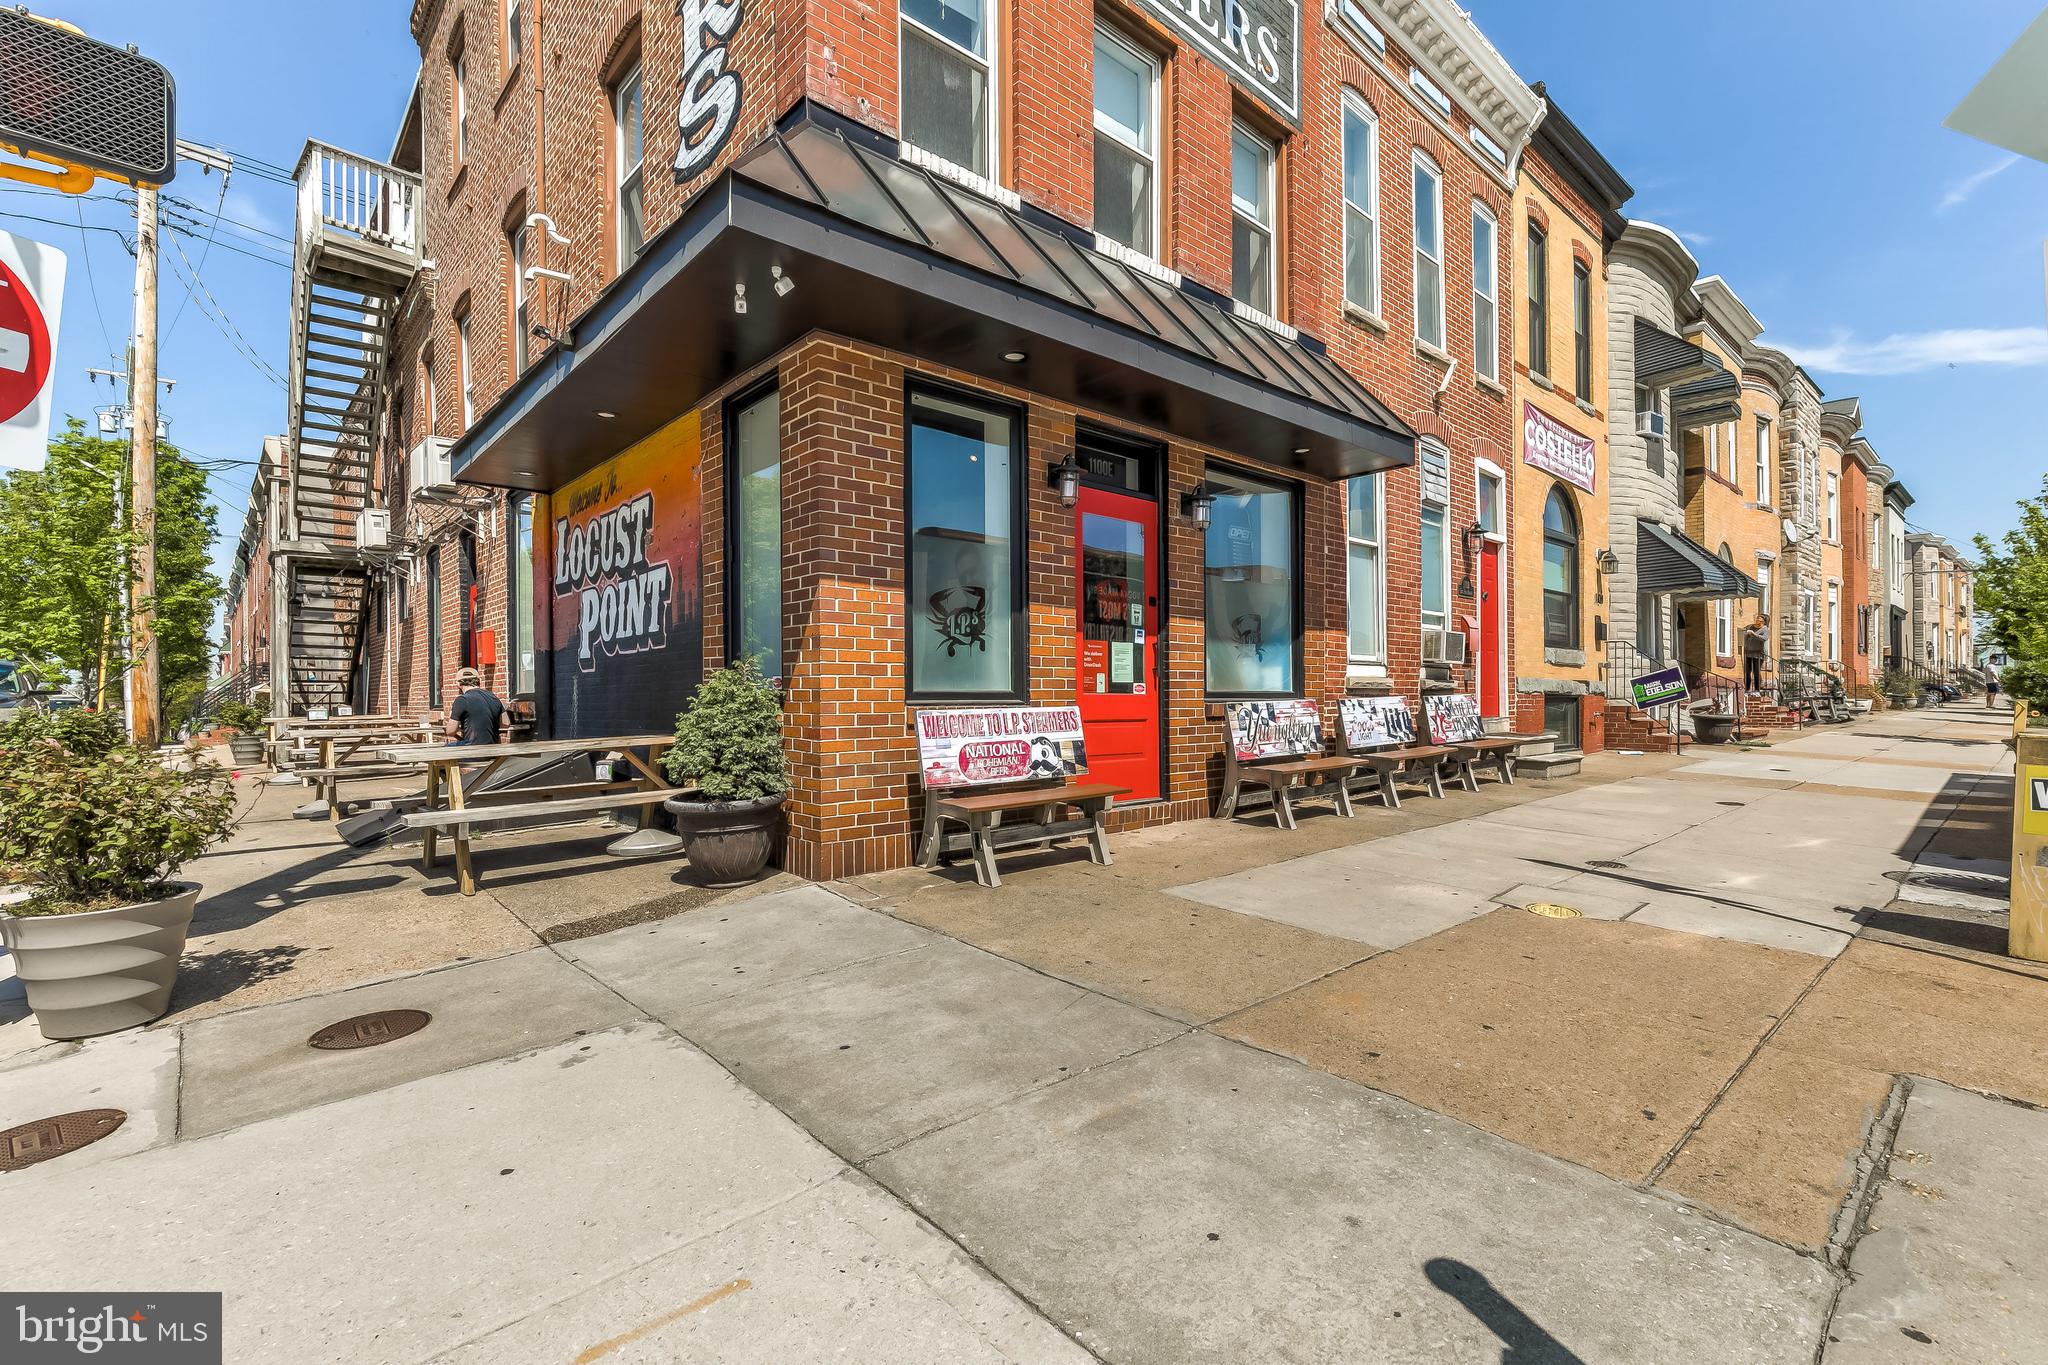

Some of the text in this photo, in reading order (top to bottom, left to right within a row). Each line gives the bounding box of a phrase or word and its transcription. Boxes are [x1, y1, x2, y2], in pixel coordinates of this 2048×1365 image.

[1525, 419, 1594, 476] COSTELLO
[1089, 457, 1113, 477] 1100E
[556, 494, 651, 585] LOCUST
[580, 566, 668, 660] POINT
[1646, 680, 1684, 697] EDELSON
[922, 713, 985, 739] WELCOME
[985, 713, 1000, 737] TO
[1022, 710, 1080, 735] STEAMERS
[965, 743, 1026, 759] NATIONAL
[990, 766, 1009, 776] BEER
